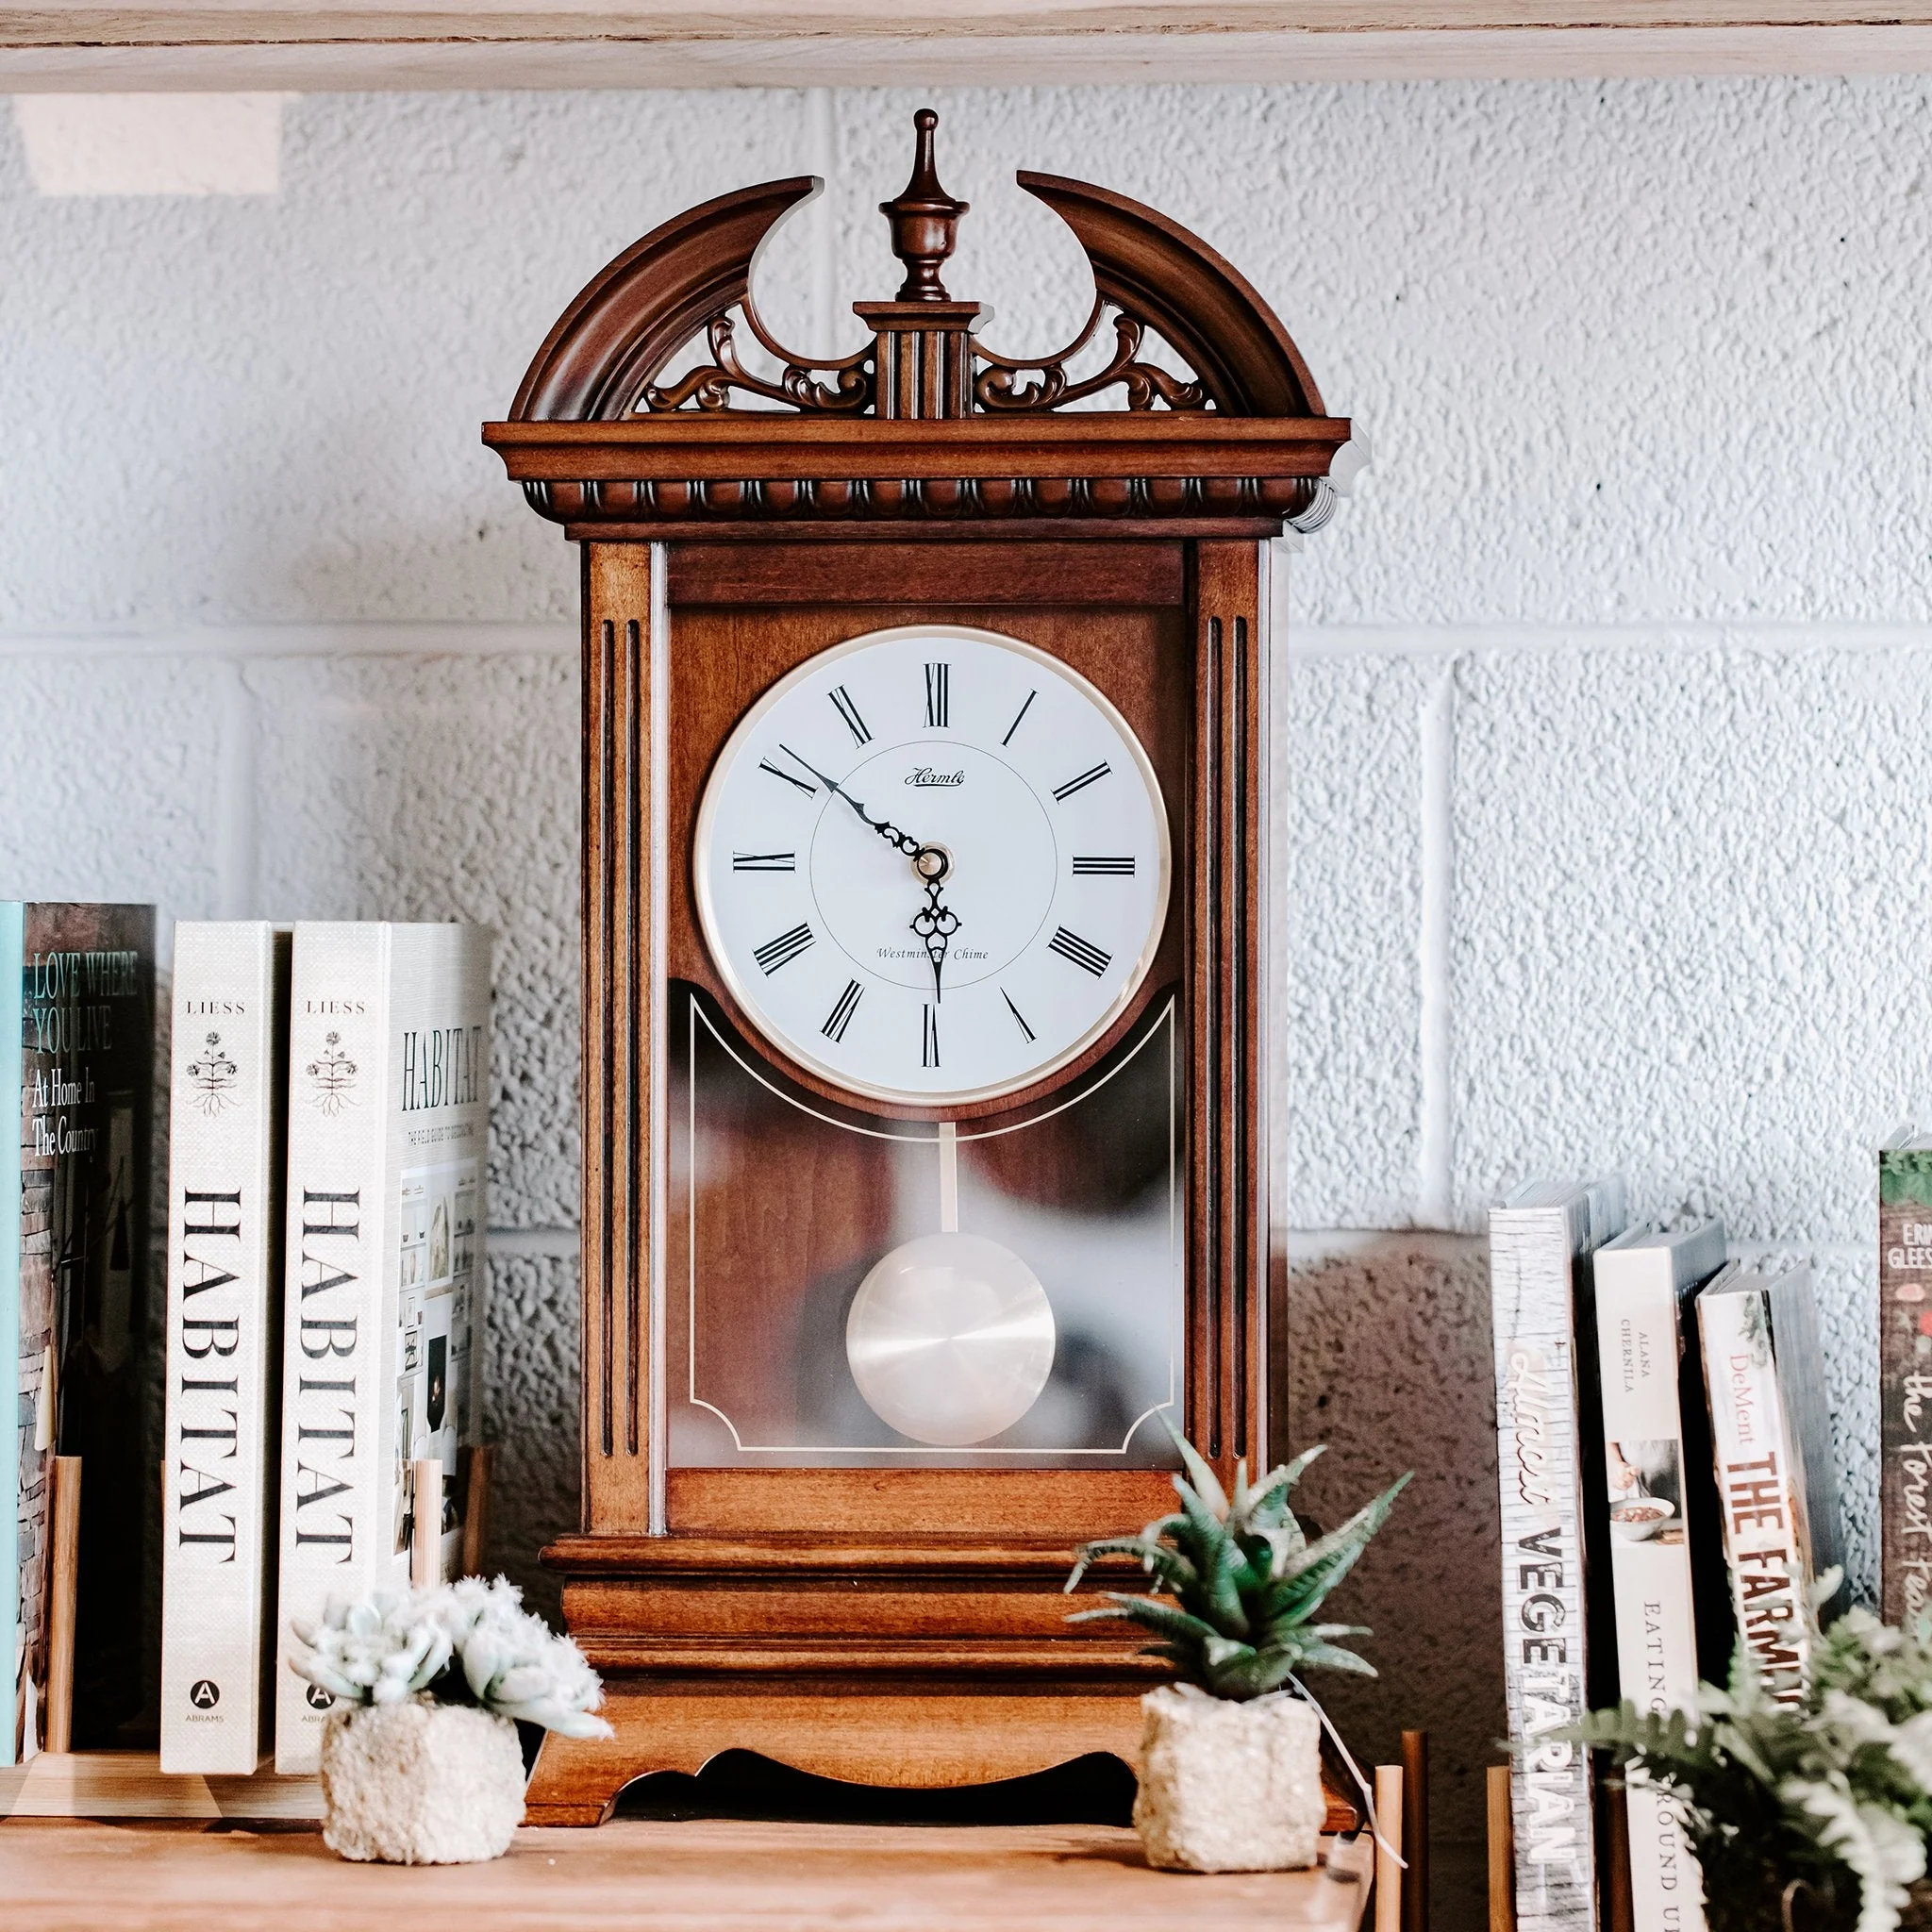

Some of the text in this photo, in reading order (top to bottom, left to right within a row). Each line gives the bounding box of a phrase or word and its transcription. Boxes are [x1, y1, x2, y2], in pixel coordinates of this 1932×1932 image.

[904, 767, 965, 788] Hermle
[1072, 855, 1136, 878] III
[33, 950, 139, 1001] LOVE WHERE
[877, 947, 989, 960] Westminter Chime
[32, 1005, 112, 1055] YOU LIVE
[187, 1001, 245, 1014] LIESS
[307, 1001, 365, 1014] LIESS
[32, 1067, 95, 1108] At Home In
[402, 1026, 482, 1111] HABITAT
[32, 1117, 56, 1157] The
[179, 1186, 242, 1564] HABITAT
[296, 1186, 360, 1564] HABITAT
[1621, 1319, 1635, 1392] CHERNILA
[1639, 1331, 1651, 1378] ALANA
[1729, 1354, 1756, 1445] DeMent
[1727, 1451, 1784, 1535] THE
[1643, 1600, 1667, 1714] EATING
[193, 1681, 216, 1705] A
[1519, 1526, 1577, 1864] VEGETARIAN
[185, 1714, 225, 1724] ABRAMS
[1657, 1790, 1678, 1890] ROUND
